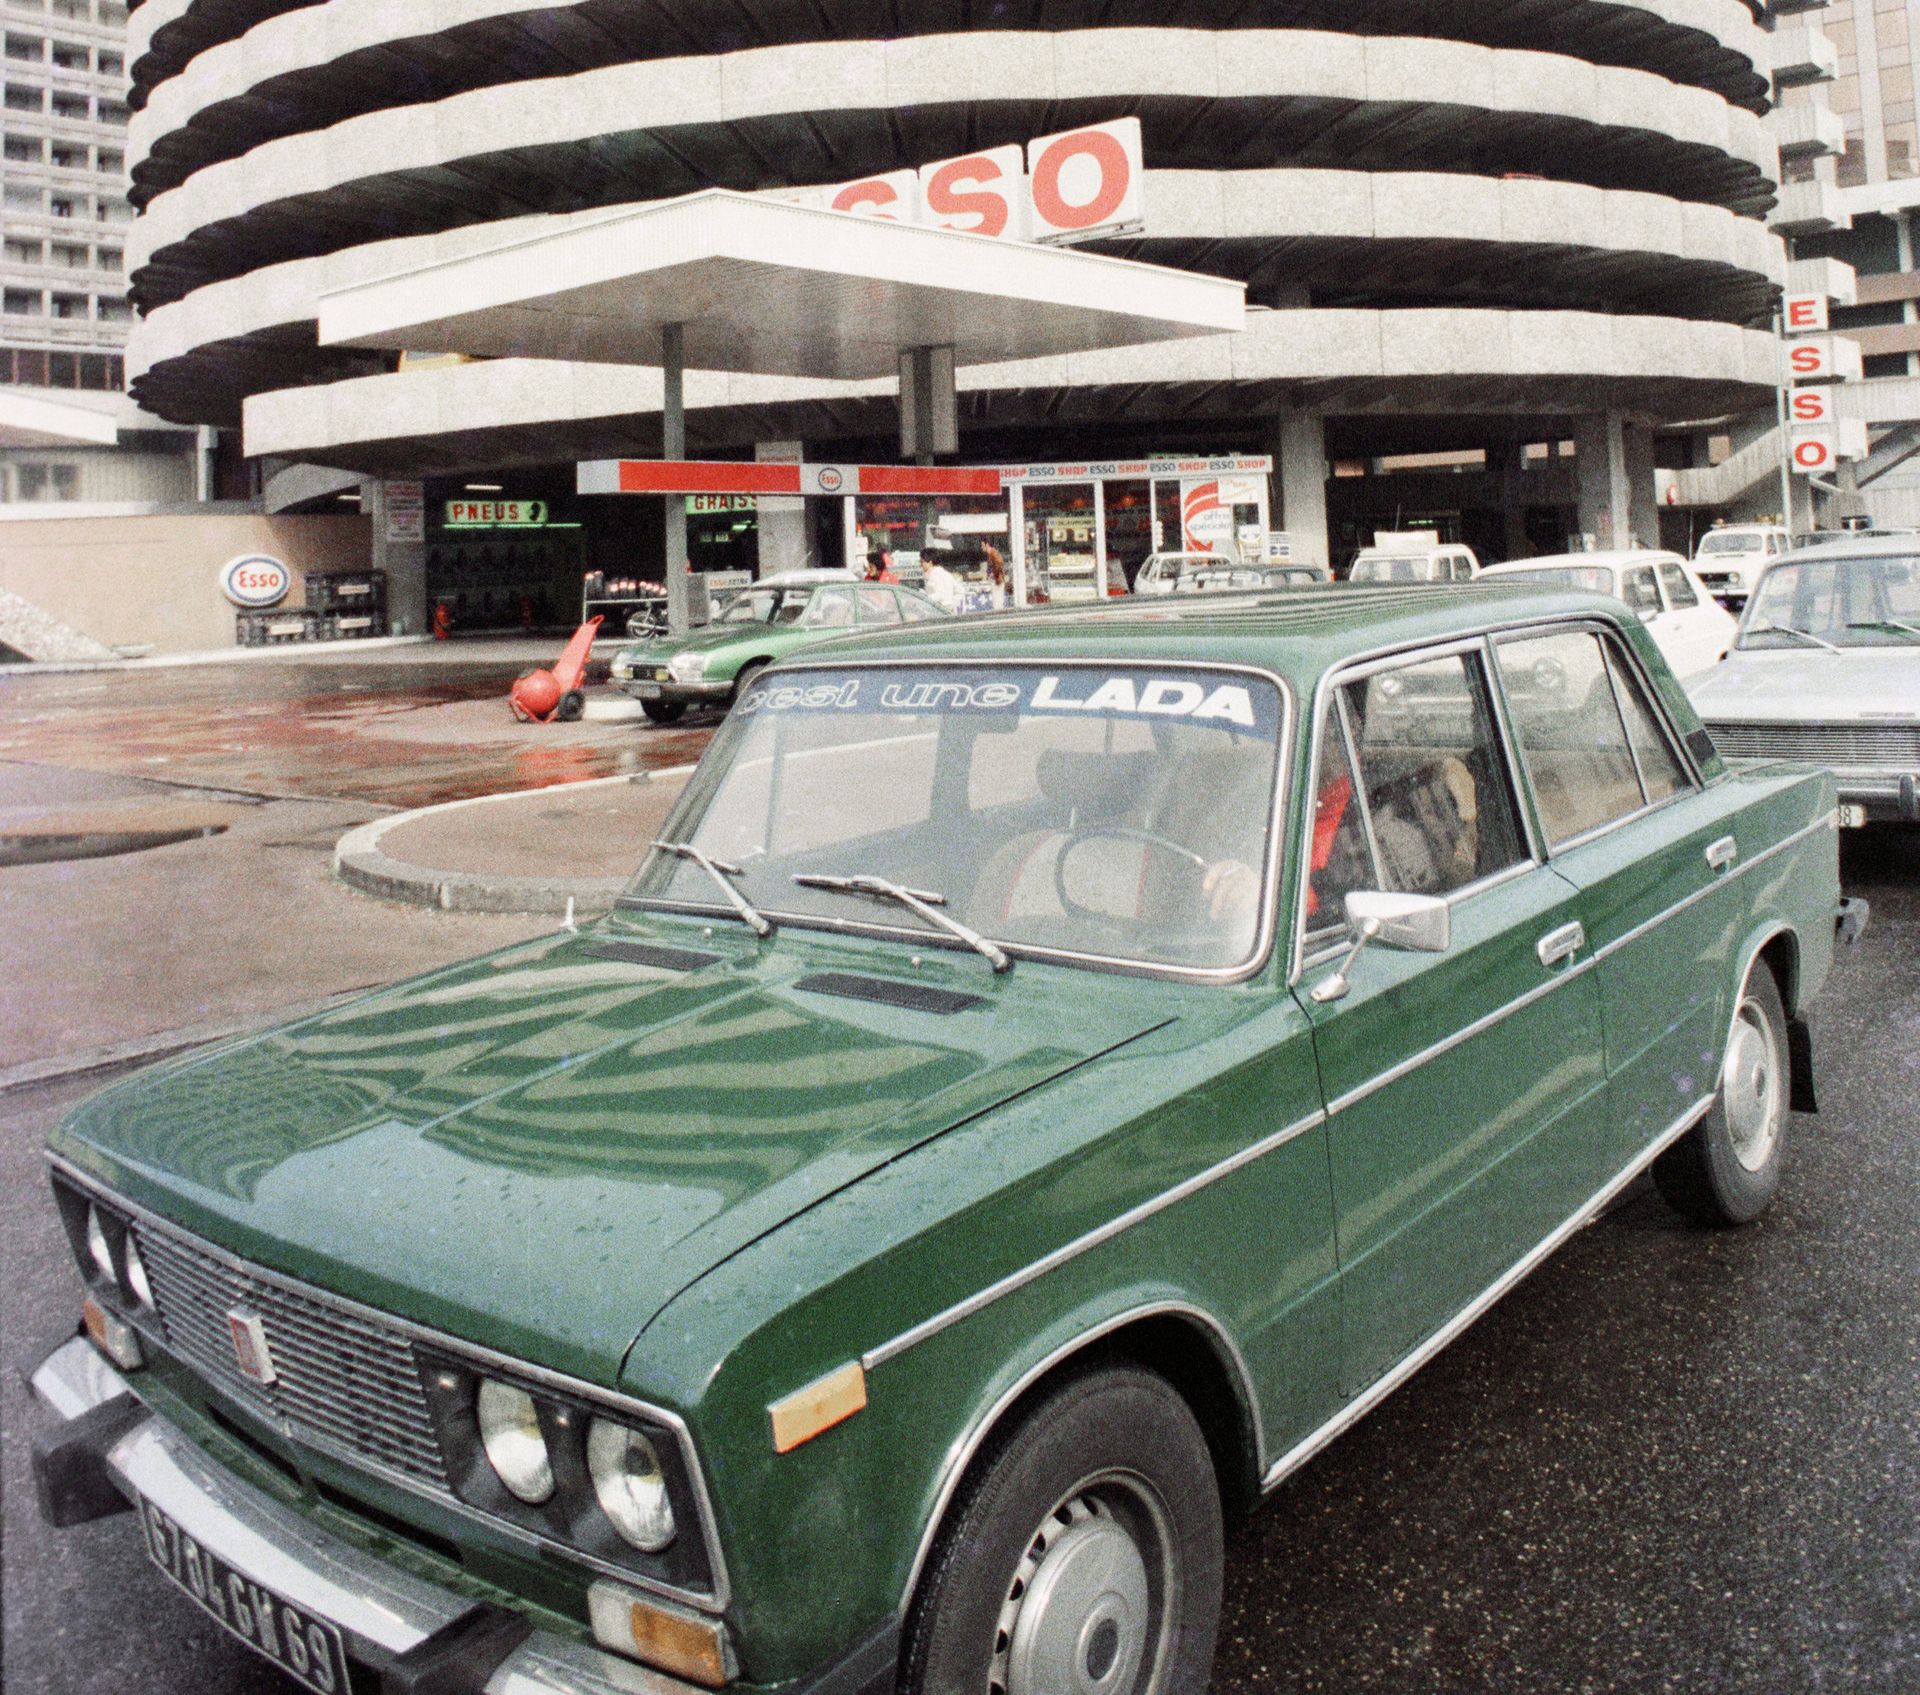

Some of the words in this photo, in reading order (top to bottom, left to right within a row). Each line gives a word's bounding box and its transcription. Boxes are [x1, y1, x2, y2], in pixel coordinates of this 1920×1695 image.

[1788, 300, 1828, 467] ESSO
[1028, 466, 1056, 477] ESSO
[1057, 465, 1088, 476] SHOP
[1089, 464, 1116, 475] ESSO
[1117, 463, 1148, 474] SHOP
[1149, 463, 1176, 473] ESSO
[1178, 462, 1208, 472] SHOP
[1209, 460, 1235, 470] ESSO
[1236, 459, 1266, 470] SHOP
[452, 503, 519, 520] PNEUS
[881, 683, 1021, 708] une
[1030, 676, 1255, 726] LADA
[282, 1606, 336, 1694] 69
